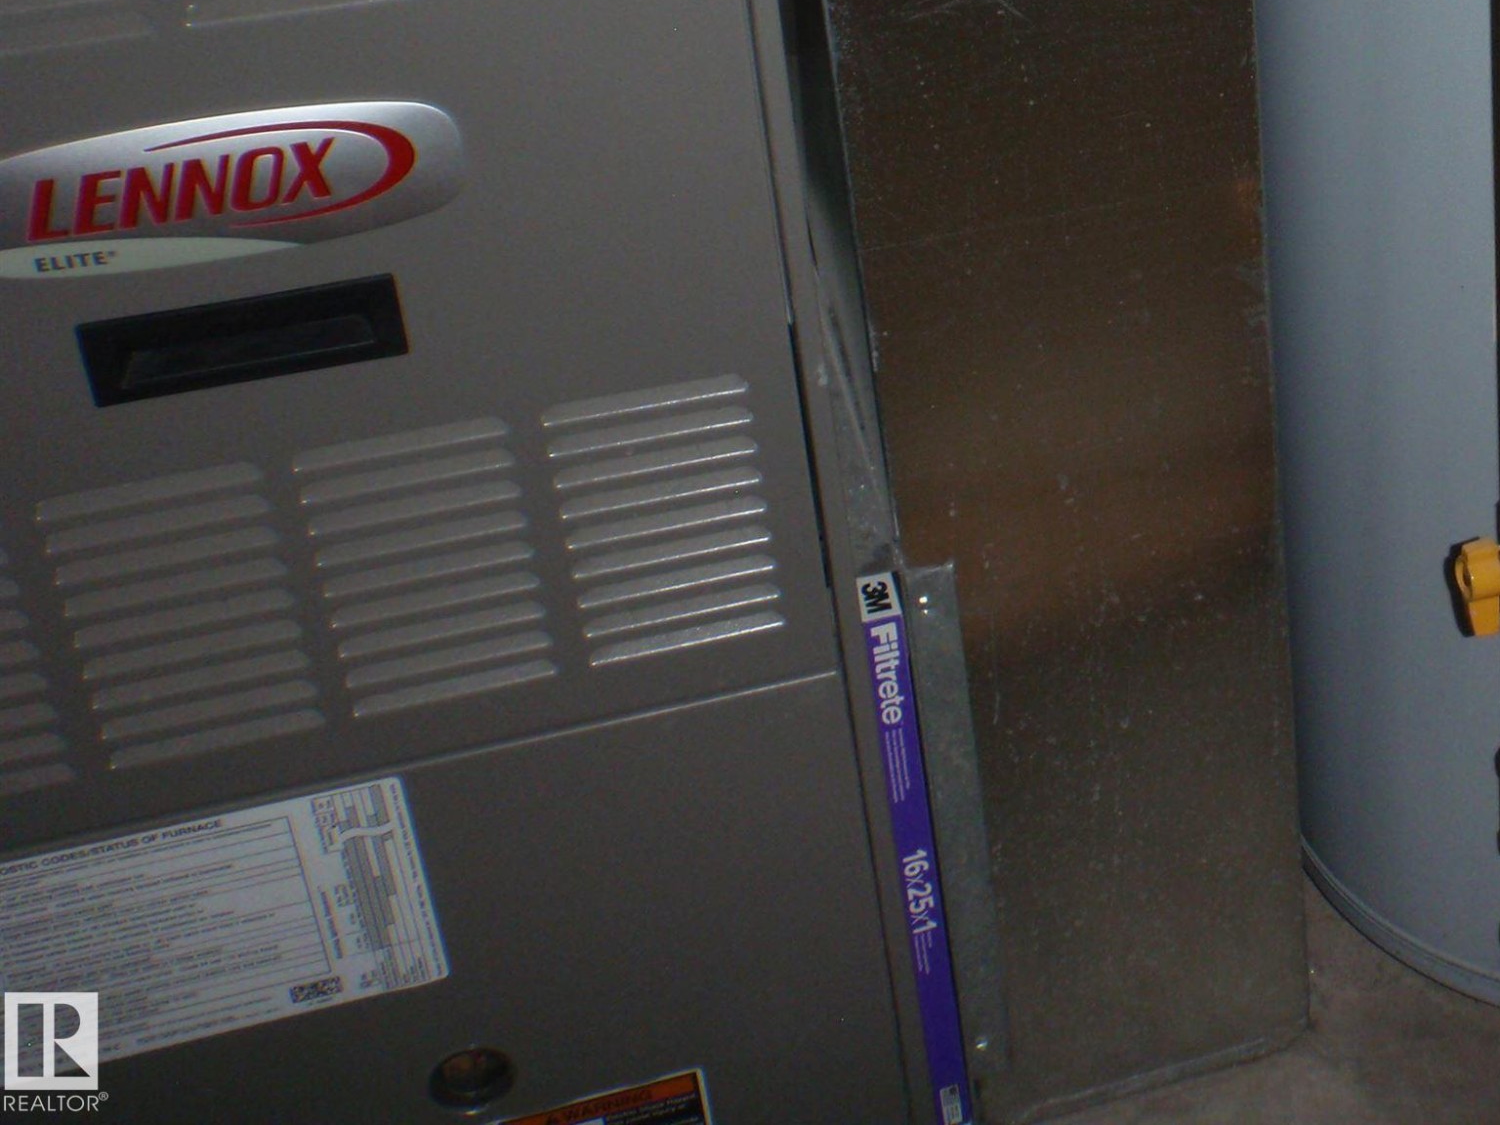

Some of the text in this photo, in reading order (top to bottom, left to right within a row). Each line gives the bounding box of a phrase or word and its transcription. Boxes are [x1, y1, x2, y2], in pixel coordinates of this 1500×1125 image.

[26, 137, 336, 242] LENNOX
[861, 580, 892, 614] 3M
[870, 622, 904, 725] Filtrete
